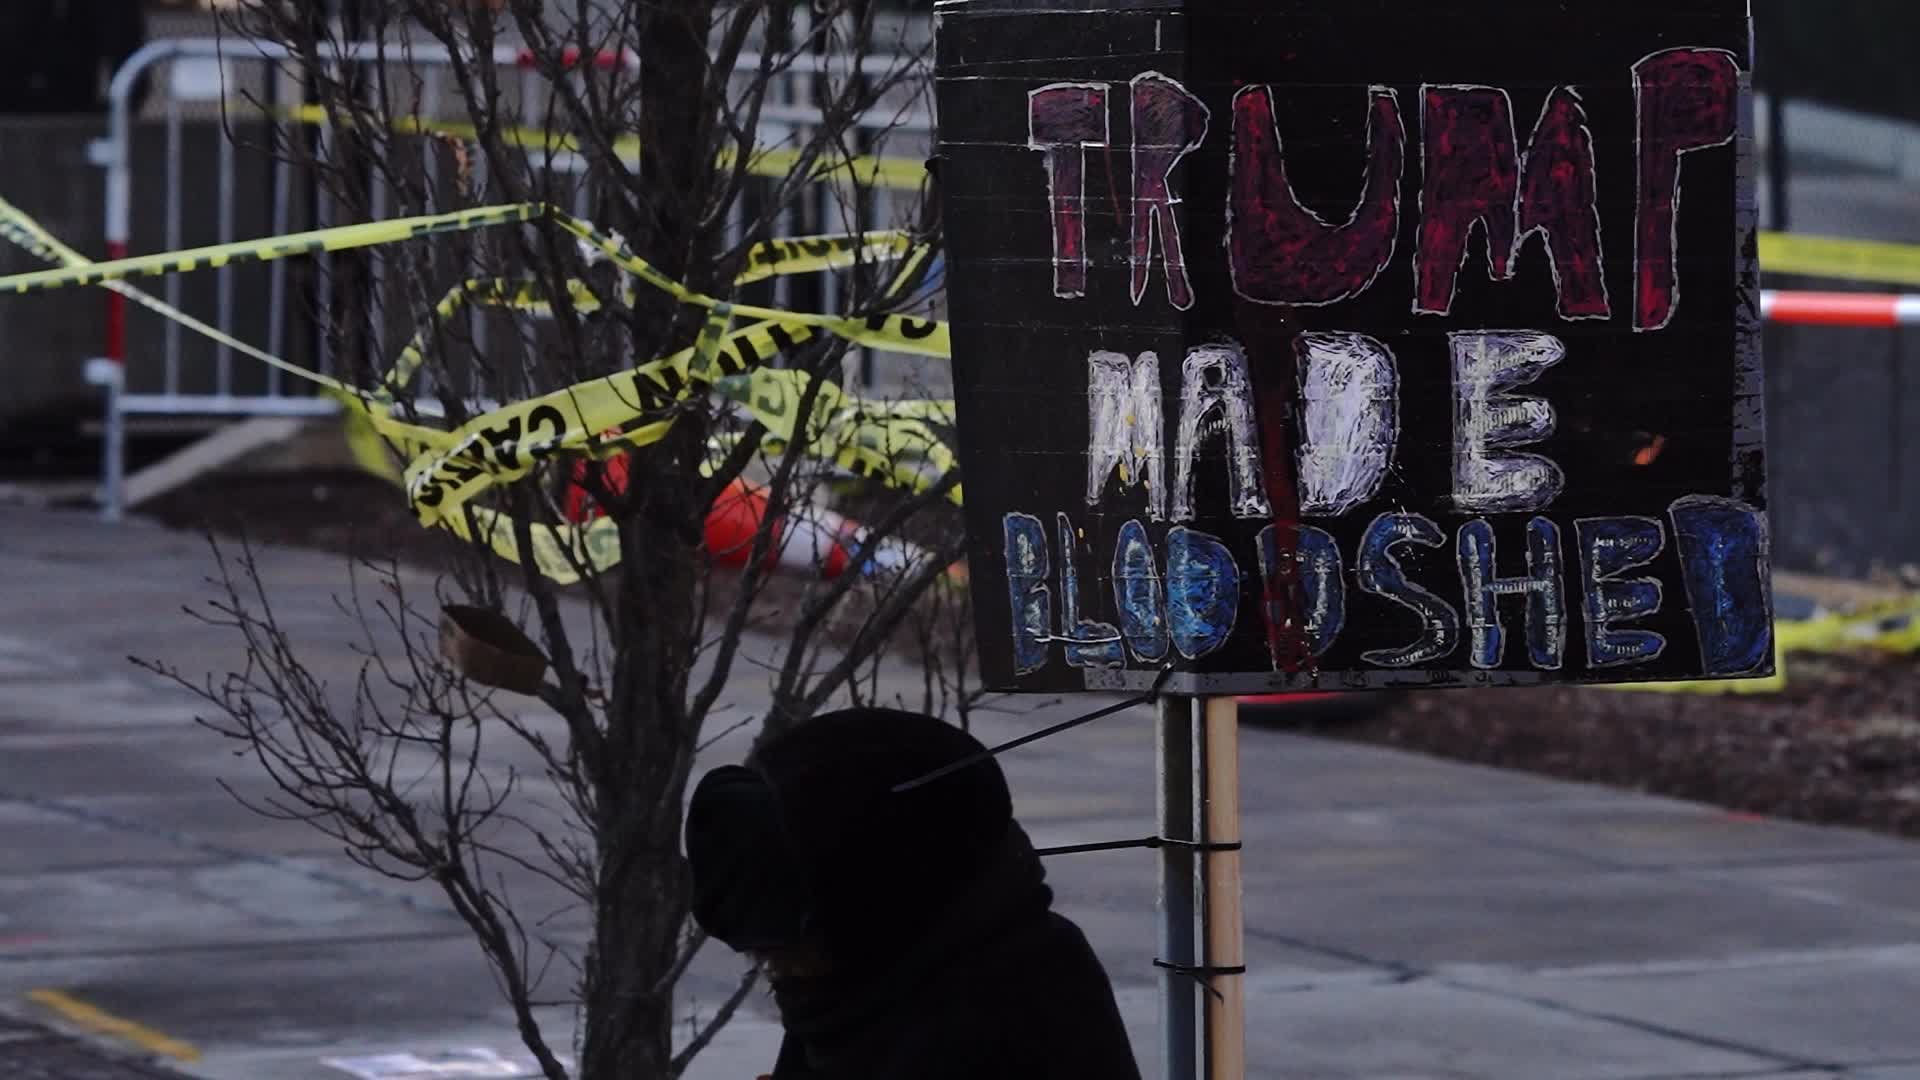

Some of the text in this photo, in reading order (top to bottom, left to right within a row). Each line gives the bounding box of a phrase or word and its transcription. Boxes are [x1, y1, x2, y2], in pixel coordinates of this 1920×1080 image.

[1027, 46, 1742, 333] TRUMP
[1086, 329, 1567, 523] MADE
[1002, 494, 1774, 677] BLOODSHED
